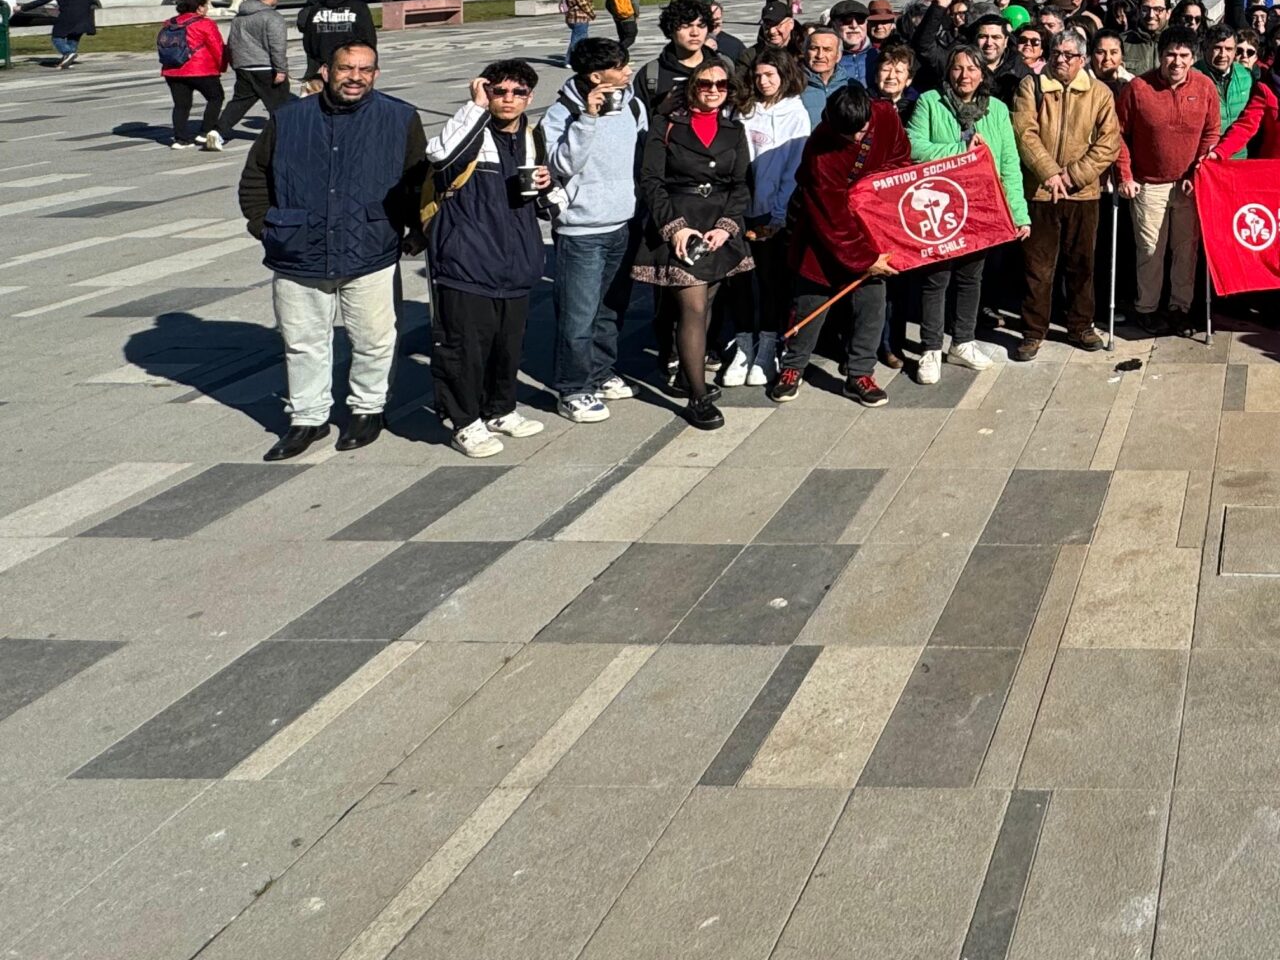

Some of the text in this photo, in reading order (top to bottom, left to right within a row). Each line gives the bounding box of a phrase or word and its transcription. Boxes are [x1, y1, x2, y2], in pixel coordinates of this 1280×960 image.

[312, 9, 357, 23] Atlanta
[872, 152, 978, 191] PARTIDO SOCIALISTA
[920, 237, 967, 259] DE CHILE
